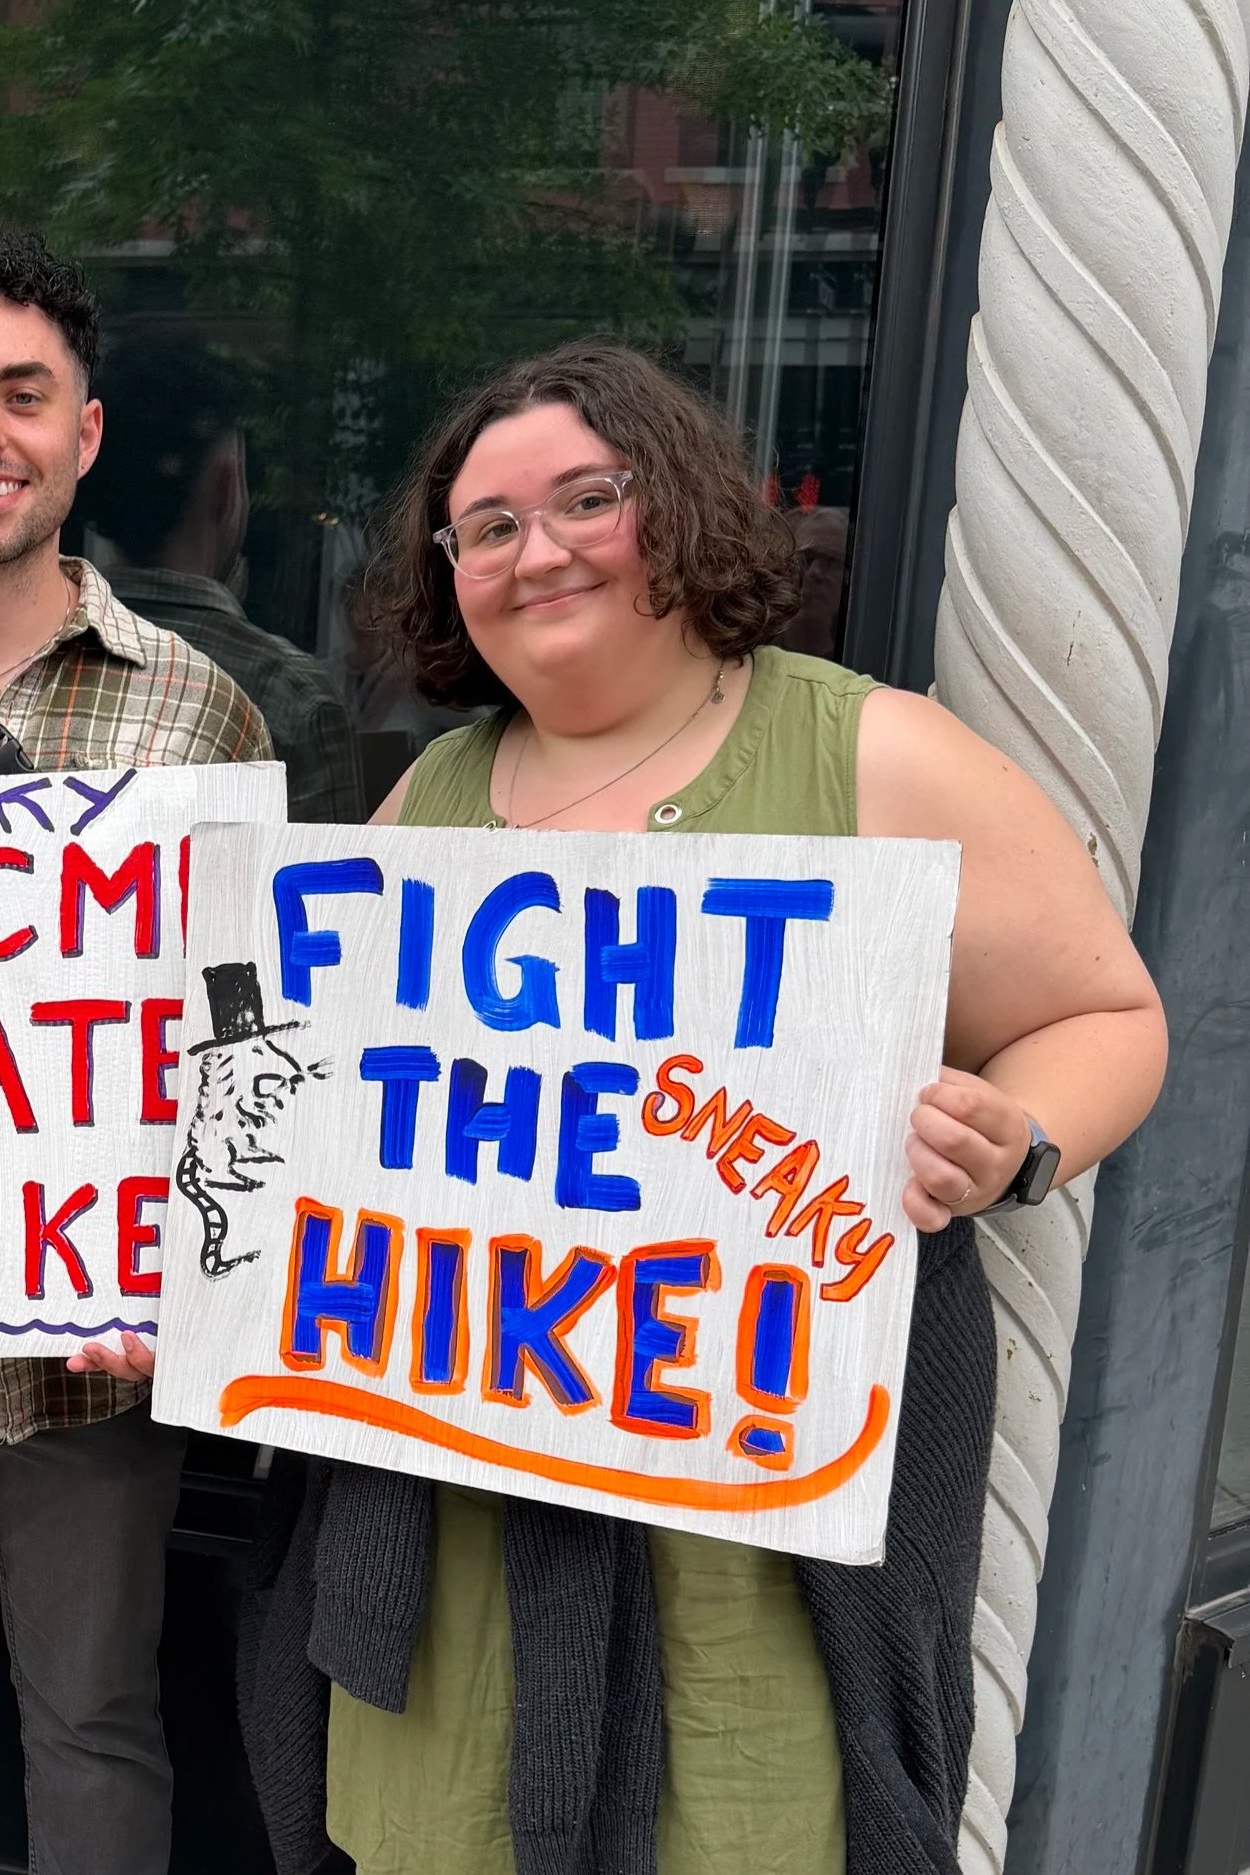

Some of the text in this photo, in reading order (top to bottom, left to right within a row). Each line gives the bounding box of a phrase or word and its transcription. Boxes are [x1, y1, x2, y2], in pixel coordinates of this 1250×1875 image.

[272, 856, 835, 1050] FIGHT
[358, 1045, 642, 1211] THE
[640, 1053, 895, 1302] SNEAKY
[280, 1195, 810, 1471] HIKE!
